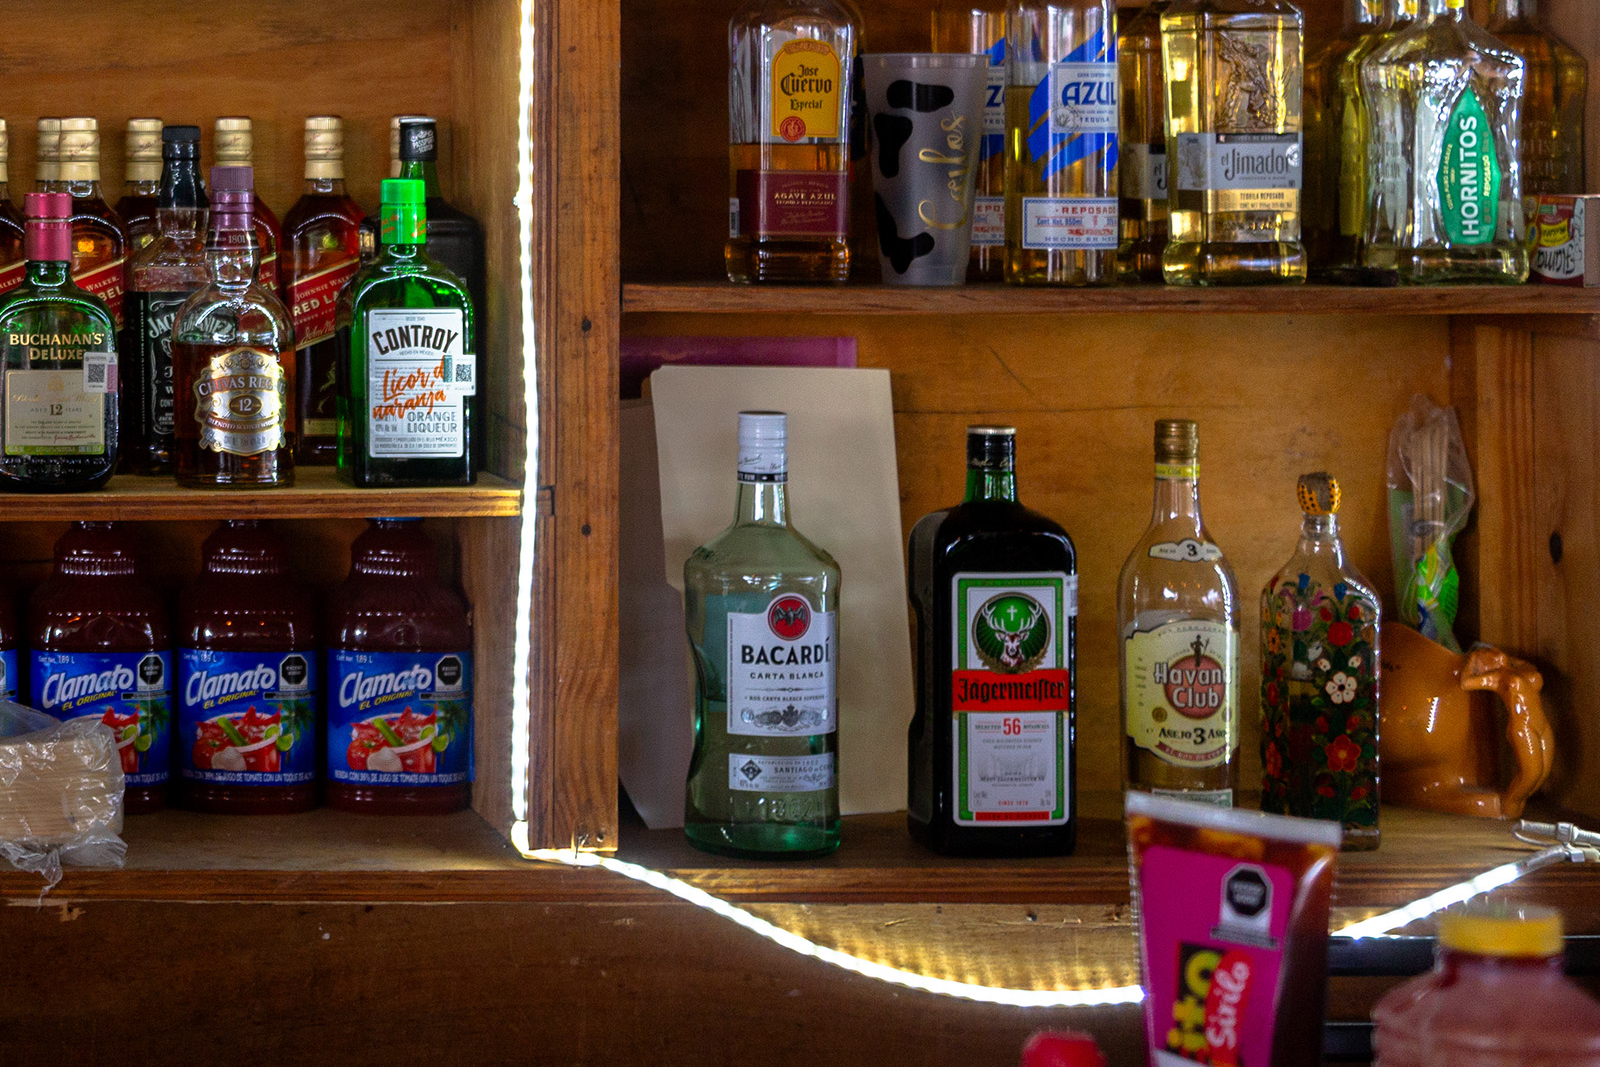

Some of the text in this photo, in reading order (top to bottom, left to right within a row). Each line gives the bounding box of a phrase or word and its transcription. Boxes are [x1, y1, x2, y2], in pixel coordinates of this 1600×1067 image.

[797, 63, 819, 79] Jose
[780, 72, 833, 96] Cuervo
[790, 99, 823, 111] Especial
[1061, 83, 1118, 107] AZUL
[1078, 115, 1110, 124] TEQUILA
[1224, 148, 1293, 181] Jimador
[1459, 115, 1480, 236] HORNITOS
[1482, 154, 1492, 197] REPOSADO
[228, 235, 247, 244] 1801
[295, 282, 328, 302] JOHNNIE
[293, 297, 321, 318] RED
[9, 331, 106, 348] BUCHANAN'S
[371, 325, 458, 356] CONTROY
[197, 376, 247, 396] CHIVAS
[49, 403, 63, 416] 12
[238, 398, 253, 413] 12
[372, 389, 447, 421] naranja
[407, 411, 457, 423] ORANGE
[407, 422, 458, 434] LIQUEUR
[1186, 543, 1197, 556] 3
[740, 636, 830, 666] BACARDÍ
[184, 662, 278, 709] Clamato
[339, 663, 434, 709] Clamato
[749, 671, 825, 681] CARTA BLANCA
[42, 663, 135, 711] Clamato
[957, 675, 1066, 705] Jägermeister
[61, 689, 120, 712] EL ORIGINAL
[202, 688, 261, 710] EL ORIGINAL
[359, 689, 417, 711] EL ORIGINAL
[1172, 687, 1220, 710] Club
[1003, 717, 1021, 736] 56
[1158, 728, 1206, 746] AÑEJO 3
[774, 765, 813, 775] SANTIAGO
